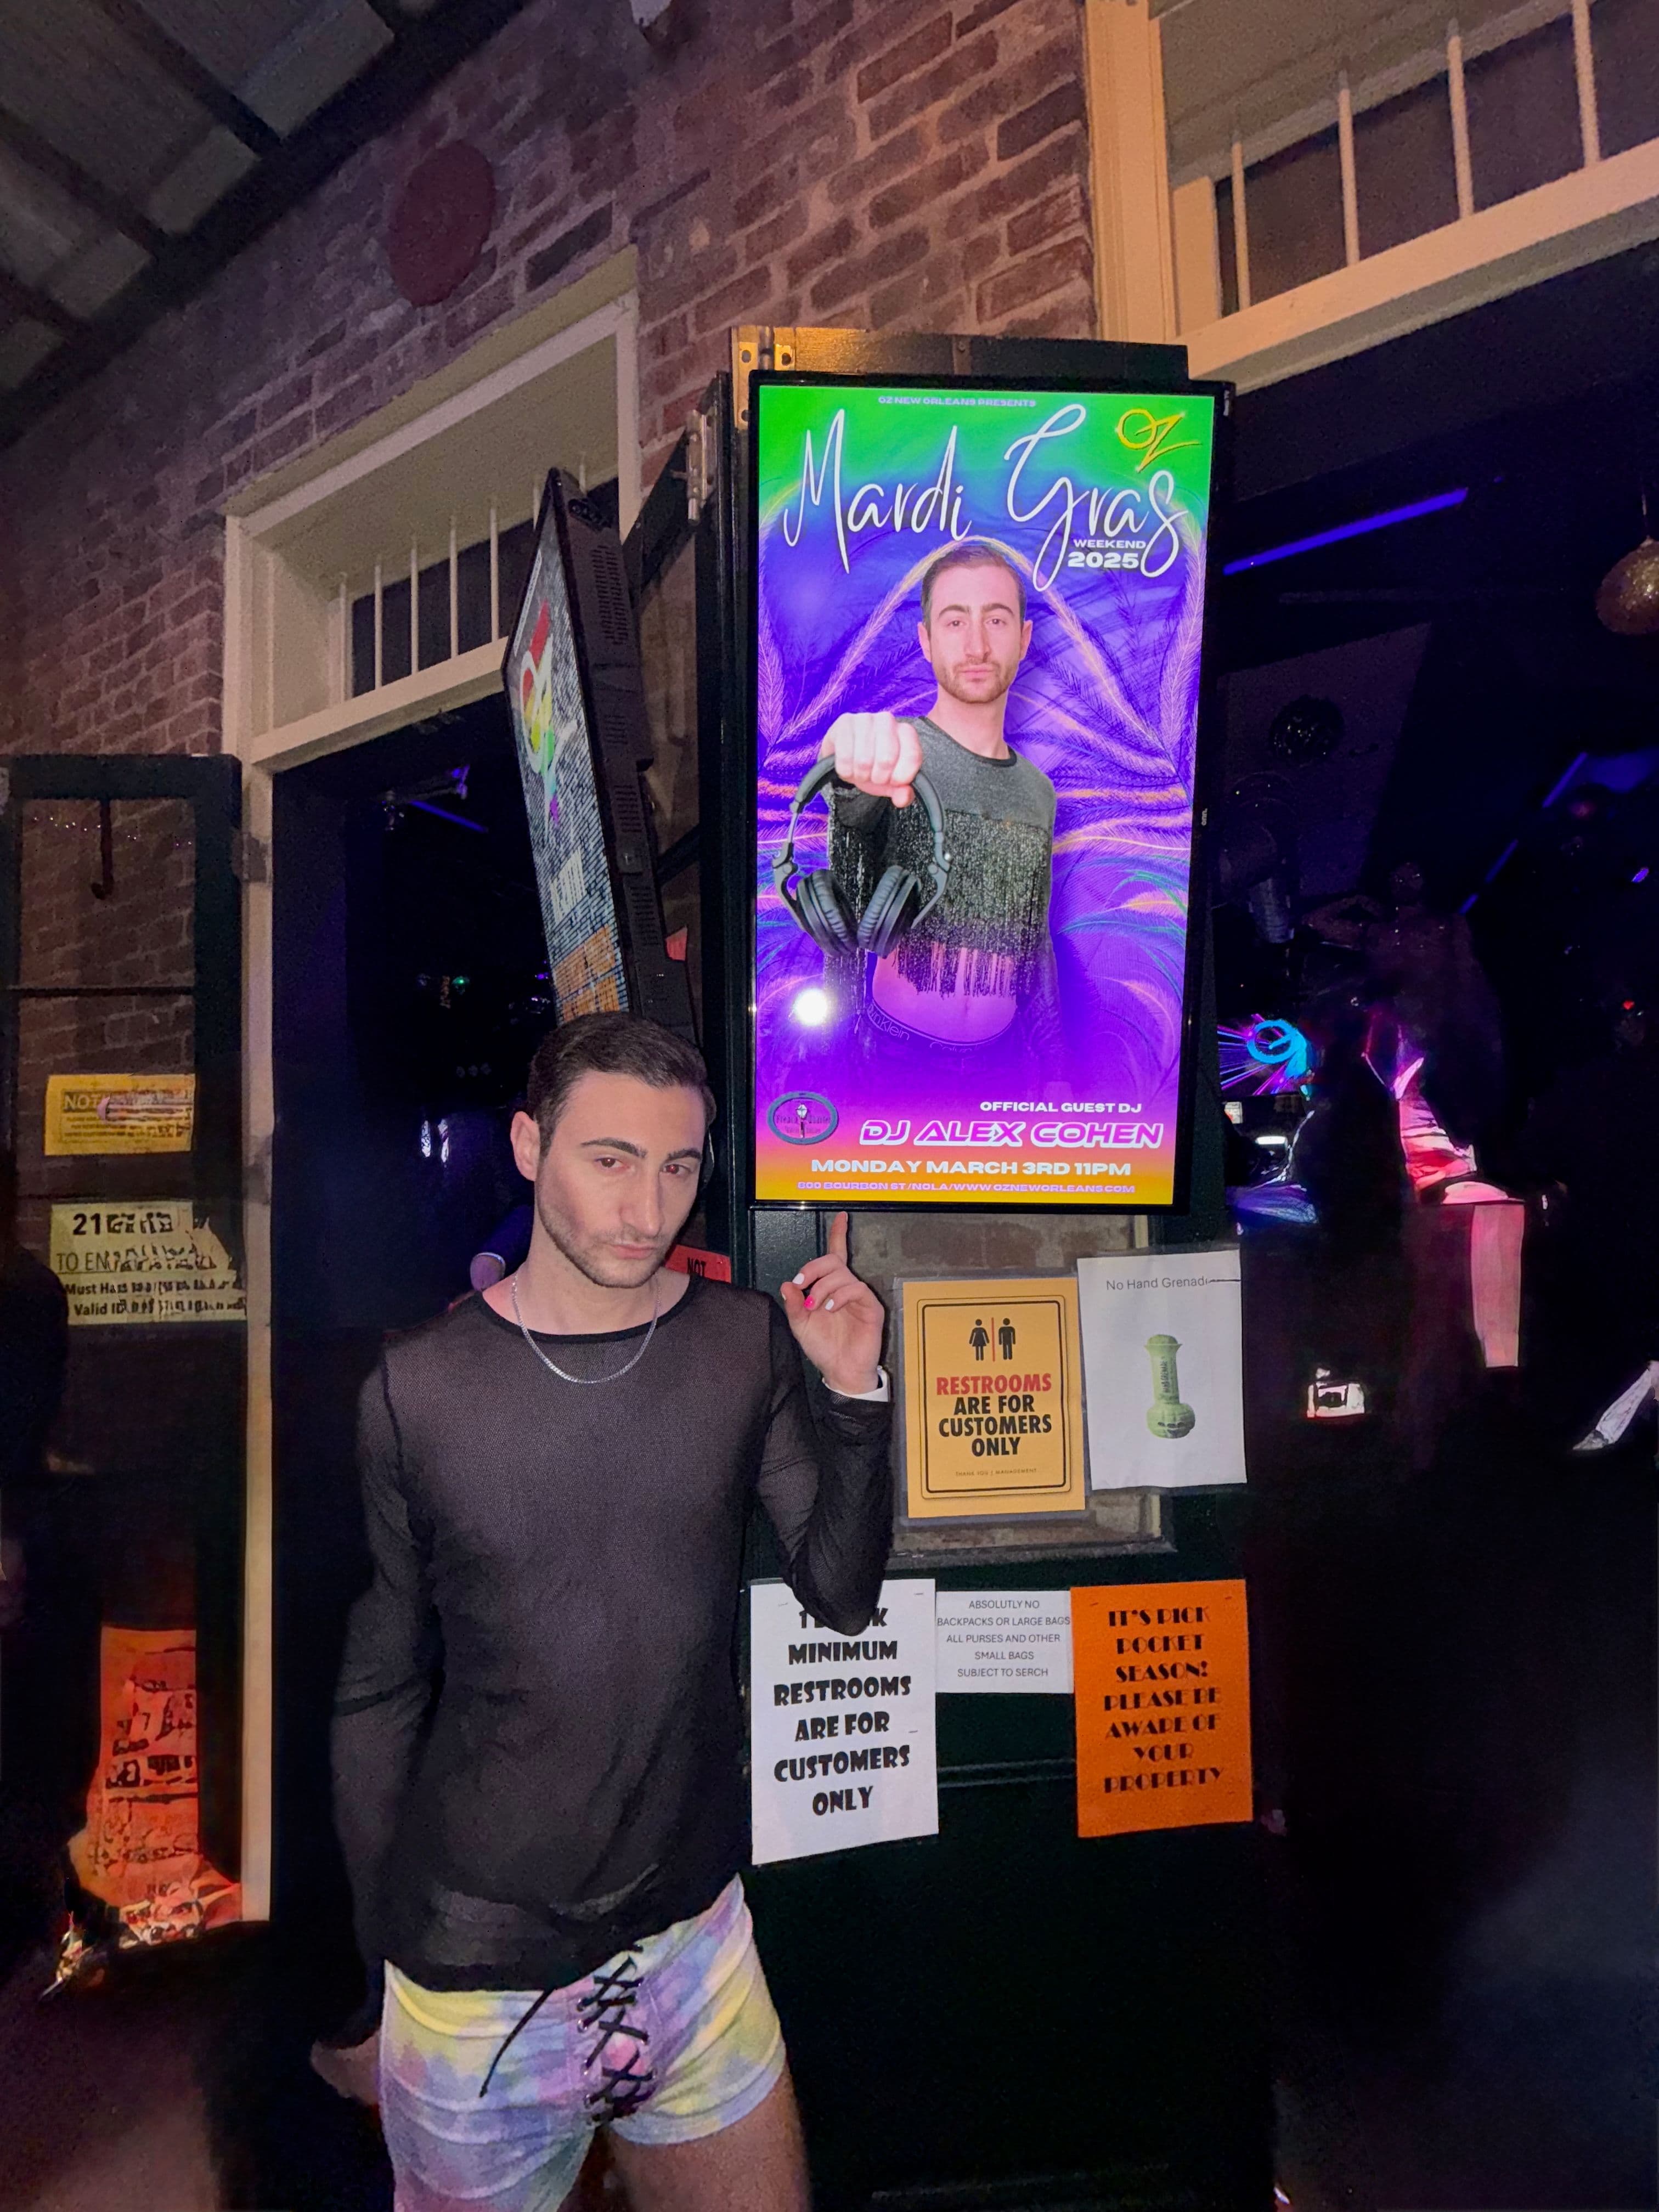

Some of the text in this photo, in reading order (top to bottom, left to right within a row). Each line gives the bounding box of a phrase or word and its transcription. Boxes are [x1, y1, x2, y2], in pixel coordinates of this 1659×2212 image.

[878, 396, 1036, 407] OZ NEW ORLEANS PRESENTS
[783, 404, 1189, 591] Mardi Gras
[1073, 539, 1146, 549] WEEKEND
[1068, 551, 1139, 569] 2025
[979, 1102, 1142, 1113] OFFICIAL GUEST DJ
[860, 1120, 1164, 1149] DJ ALEX COHEN
[811, 1159, 1131, 1176] MONDAY MARCH 3RD 11PM
[823, 1182, 888, 1190] BOURBON
[72, 1212, 101, 1234] 21
[57, 1252, 80, 1272] TO
[65, 1283, 97, 1295] Must
[1106, 1276, 1207, 1290] No Hand Grenad
[74, 1302, 107, 1316] Valid
[936, 1373, 1052, 1395] RESTROOMS
[953, 1394, 1035, 1415] ARE FOR
[939, 1414, 1052, 1437] CUSTOMERS
[972, 1436, 1020, 1457] ONLY
[969, 1600, 1040, 1609] ABSOLUTLY NO
[937, 1616, 1070, 1626] BACKPACKS OR LARGE BAGS
[1157, 1606, 1210, 1624] PICK
[946, 1634, 1060, 1643] ALL PURSES AND OTHER
[1117, 1634, 1205, 1654] POCKET
[788, 1640, 898, 1665] MINIMUM
[974, 1651, 1034, 1660] SMALL BAGS
[957, 1668, 1048, 1677] SUBJECT TO SERCH
[1116, 1661, 1209, 1683] SEASON!
[774, 1675, 911, 1706] RESTROOMS
[1104, 1687, 1221, 1711] PLEASE BE
[794, 1711, 890, 1742] ARE FOR
[1105, 1713, 1221, 1740] AWARE OF
[1133, 1742, 1194, 1762] YOUR
[774, 1745, 910, 1782] CUSTOMERS
[1104, 1767, 1225, 1793] PROPERTY
[812, 1786, 873, 1815] ONLY
